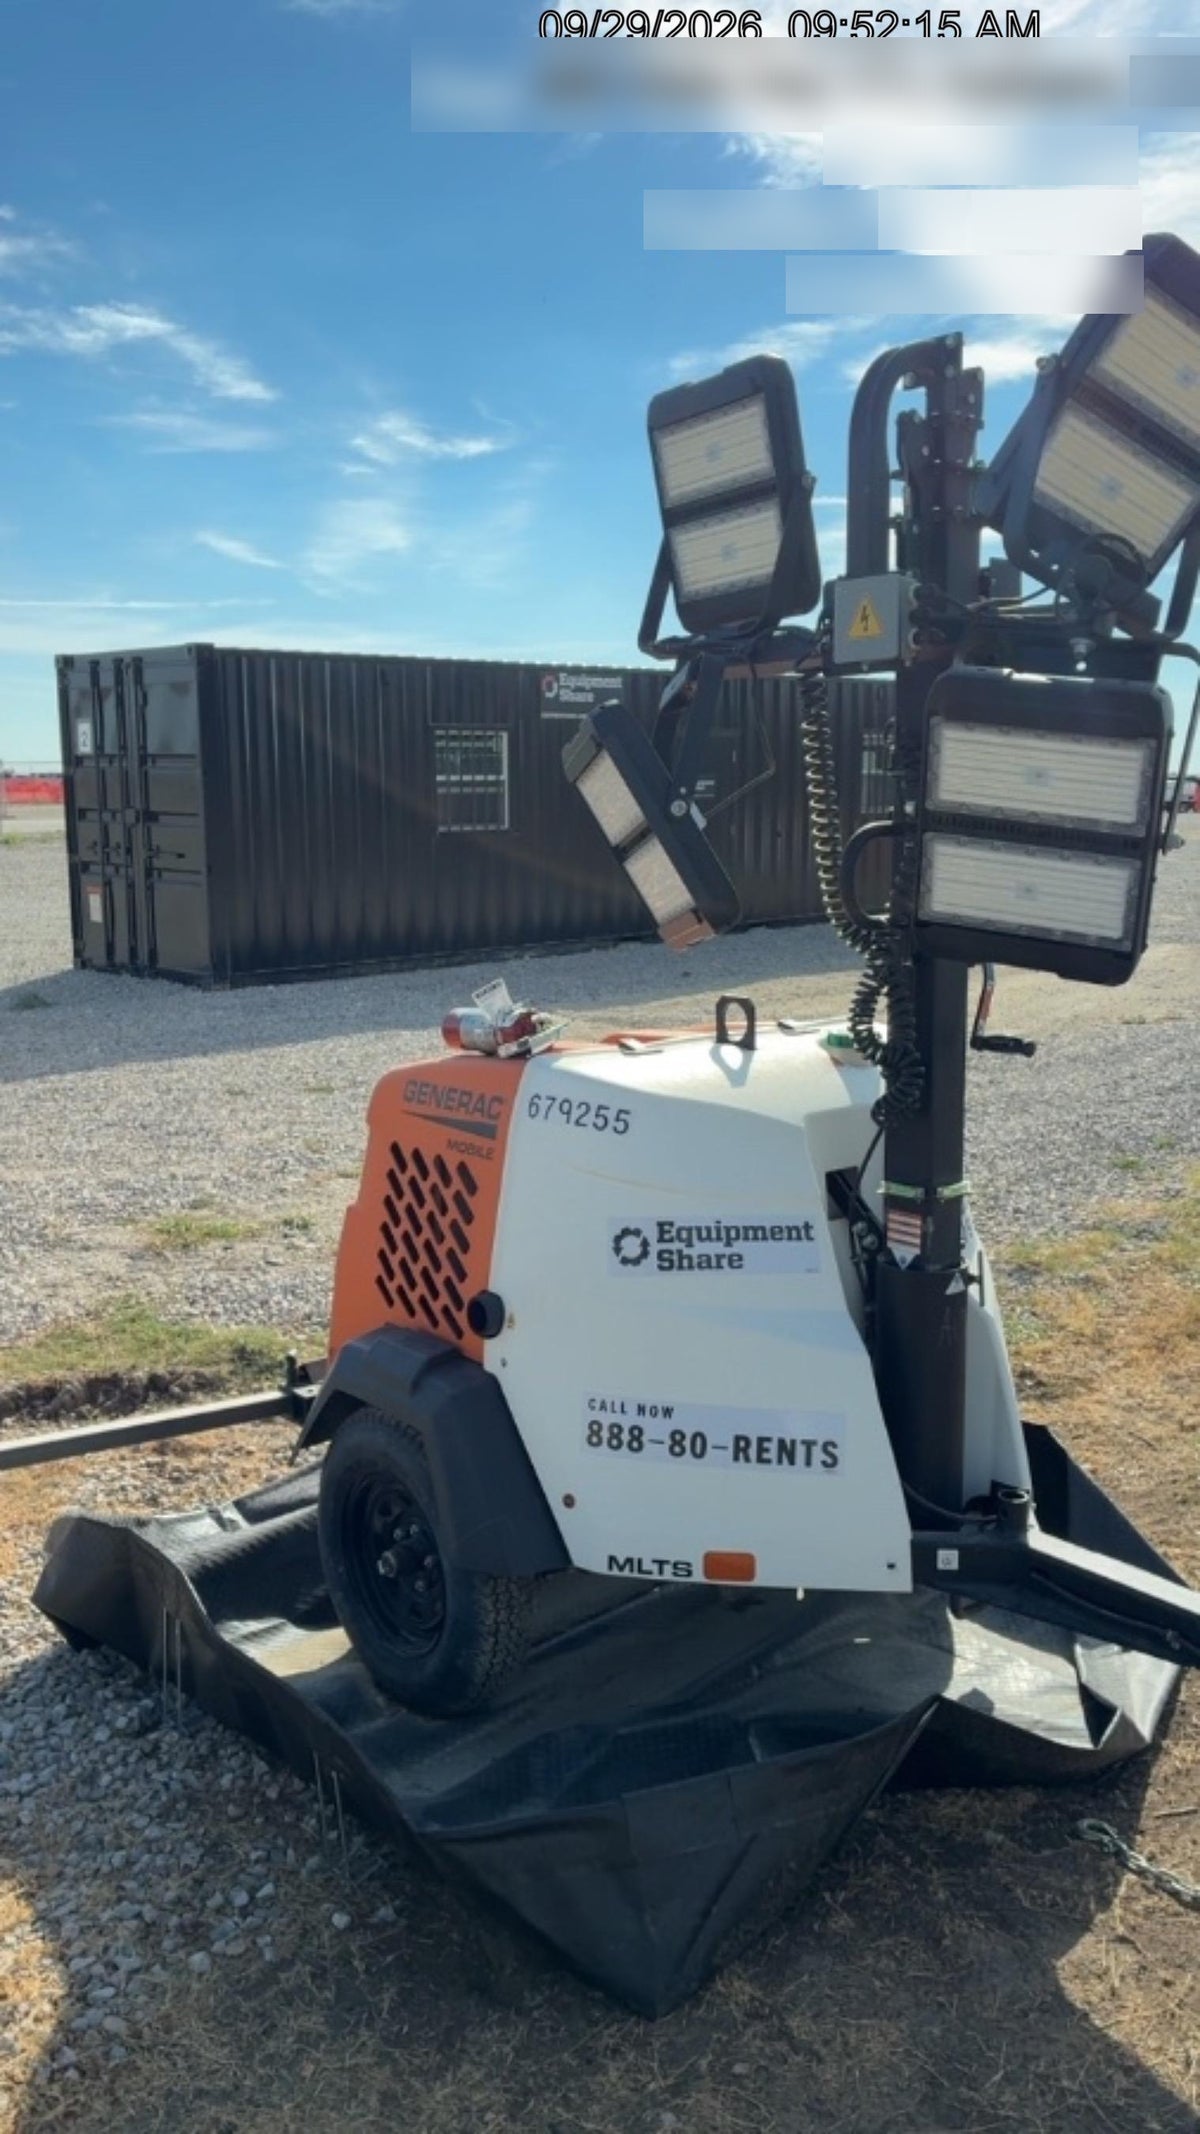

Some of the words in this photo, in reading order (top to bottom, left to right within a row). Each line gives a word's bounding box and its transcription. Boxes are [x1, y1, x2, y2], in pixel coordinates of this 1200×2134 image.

[402, 1079, 504, 1120] GENERAC
[527, 1093, 632, 1135] 679255
[446, 1138, 495, 1160] MOBILE
[656, 1220, 814, 1248] Equipment
[656, 1248, 744, 1272] Share
[587, 1398, 628, 1416] CALL
[637, 1402, 675, 1420] NOW
[586, 1418, 840, 1470] 888-80-RENTS
[607, 1554, 693, 1578] MLTS
